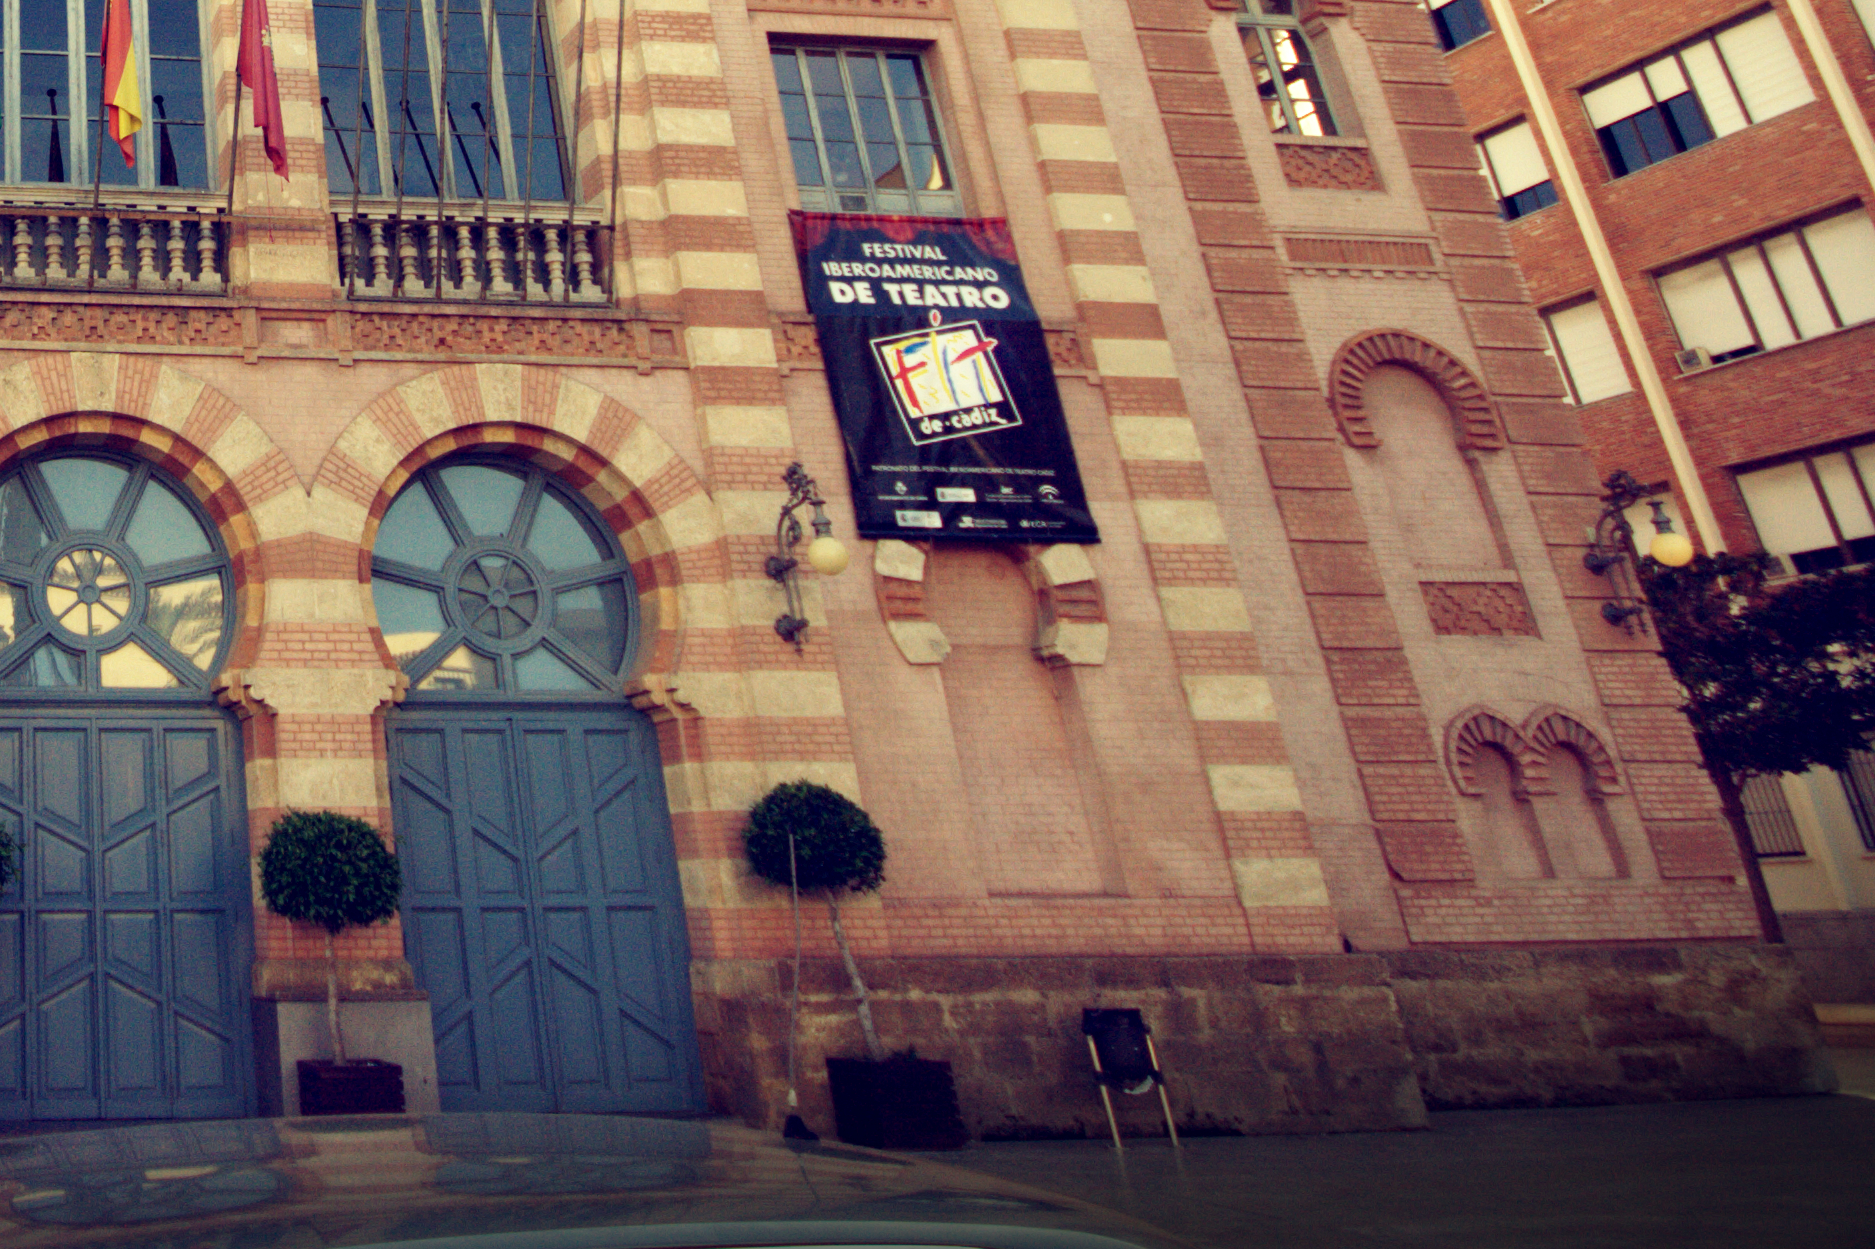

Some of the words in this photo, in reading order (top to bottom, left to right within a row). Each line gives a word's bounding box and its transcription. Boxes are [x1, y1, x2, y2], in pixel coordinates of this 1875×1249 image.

[862, 243, 947, 261] FESTIVAL
[822, 262, 999, 282] IBEROAMERICANO
[828, 281, 876, 305] DE
[882, 282, 1011, 310] TEATRO
[920, 417, 943, 434] de
